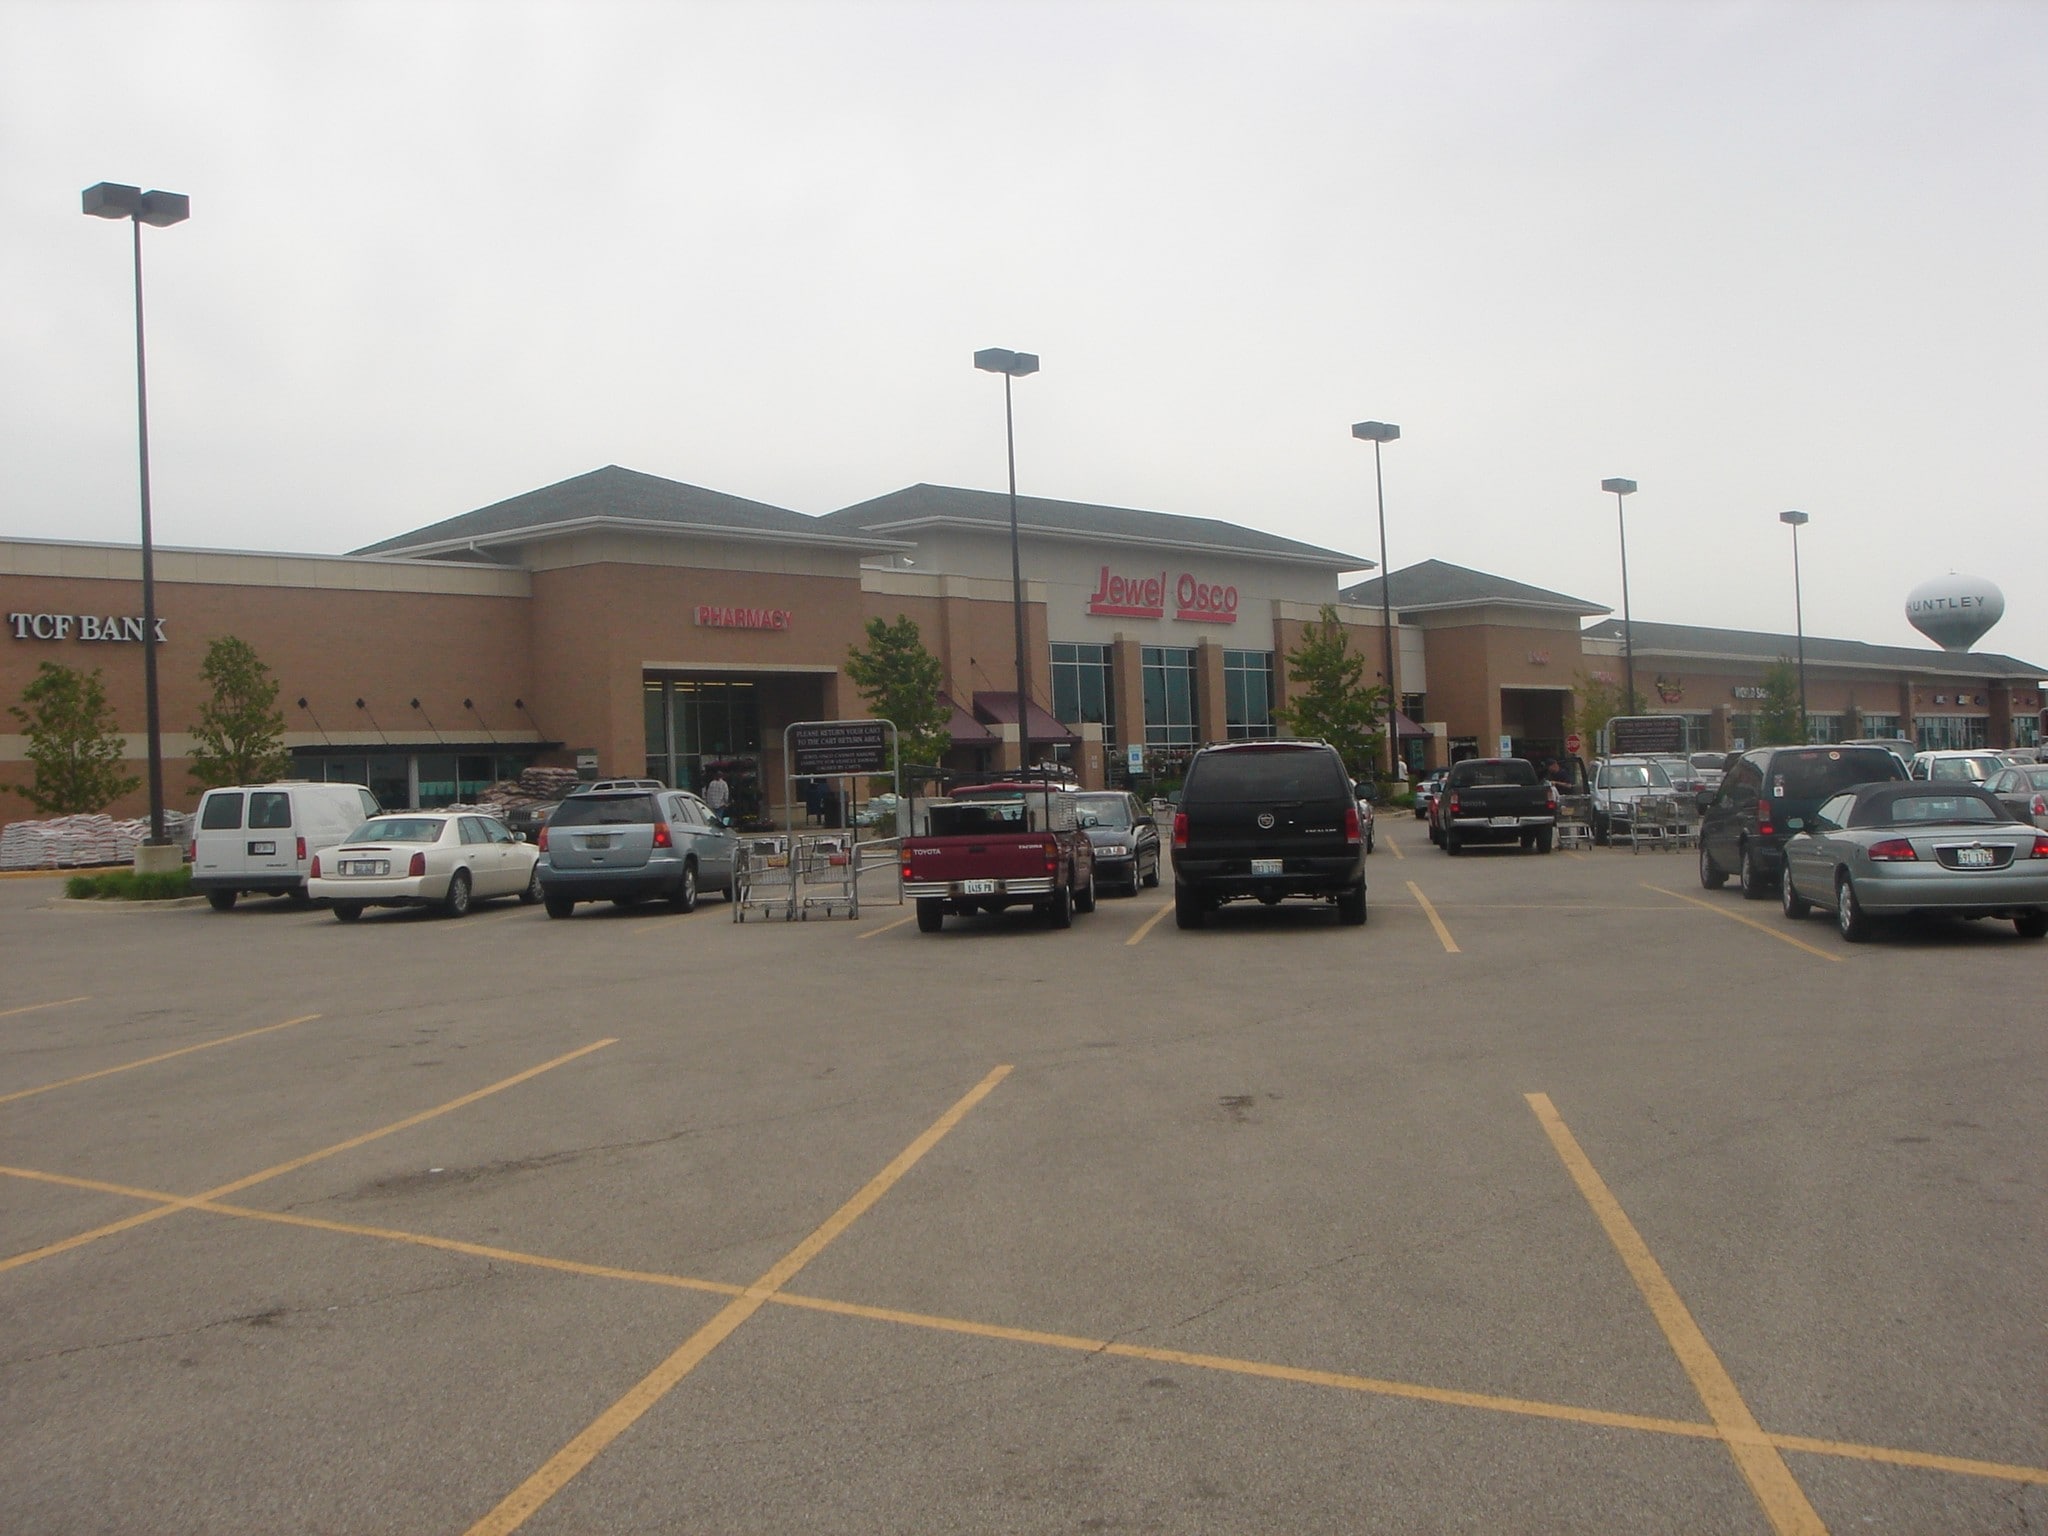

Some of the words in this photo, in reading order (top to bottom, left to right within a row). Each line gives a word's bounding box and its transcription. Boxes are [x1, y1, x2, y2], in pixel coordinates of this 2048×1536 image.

[1091, 566, 1166, 606] Jewel
[1177, 573, 1238, 612] Osco
[10, 613, 74, 640] TCF
[79, 615, 168, 642] BANK
[695, 606, 793, 629] PHARMACY
[797, 738, 807, 746] TO
[837, 736, 862, 744] RETURN
[864, 735, 881, 743] AREA
[820, 728, 845, 737] RETURN
[846, 727, 863, 736] YOUR
